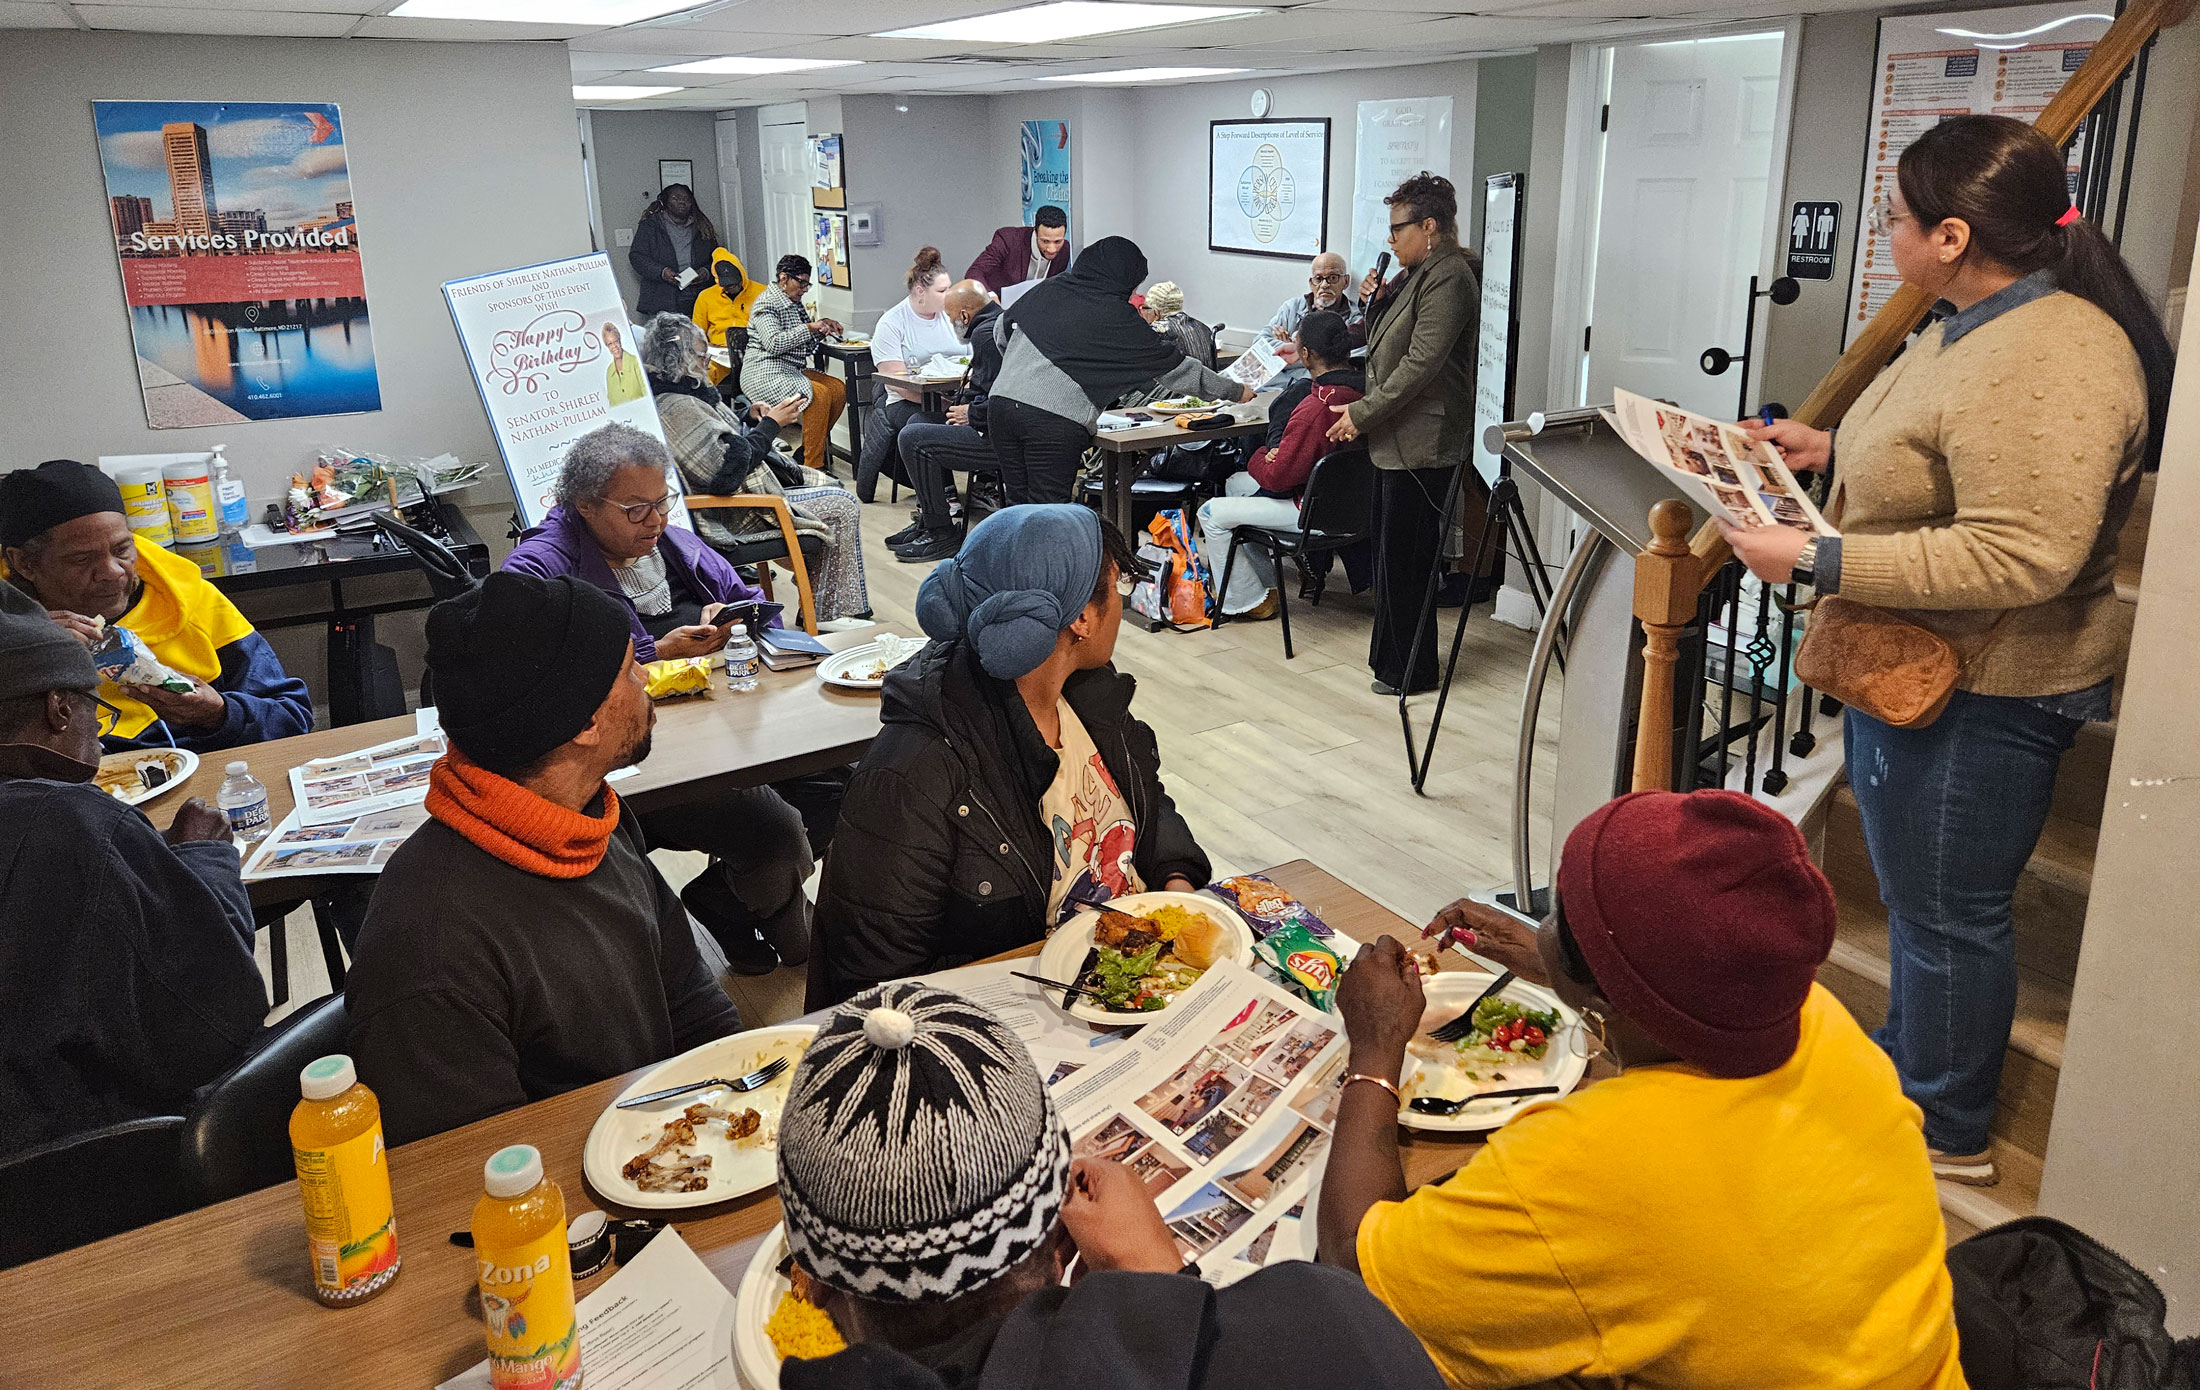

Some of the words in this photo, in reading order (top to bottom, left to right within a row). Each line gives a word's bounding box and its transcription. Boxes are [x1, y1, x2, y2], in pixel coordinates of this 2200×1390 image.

[1251, 131, 1279, 140] Descriptions
[1285, 130, 1299, 138] Level
[1033, 171, 1058, 186] Breaking
[1060, 170, 1069, 183] the
[131, 231, 238, 251] Services
[245, 227, 349, 249] Provided
[1790, 255, 1830, 264] RESTROOM
[451, 282, 491, 299] FRIENDS
[492, 280, 505, 289] OF
[506, 271, 542, 287] SHIRLEY
[542, 259, 609, 279] NATHAN-PULLIAM
[531, 281, 550, 293] AND
[487, 295, 533, 313] SPONSORS
[534, 293, 546, 302] OF
[547, 287, 566, 299] THIS
[567, 282, 591, 295] EVENT
[534, 301, 559, 313] WISH
[543, 389, 559, 402] TO
[506, 405, 558, 429] SENATOR
[559, 391, 600, 412] SHIRLEY
[510, 406, 607, 444] NATHAN-PULLIAM
[244, 804, 268, 818] DEER
[245, 812, 269, 826] PARK
[589, 1295, 627, 1325] Feedback
[502, 1353, 554, 1374] Mango
